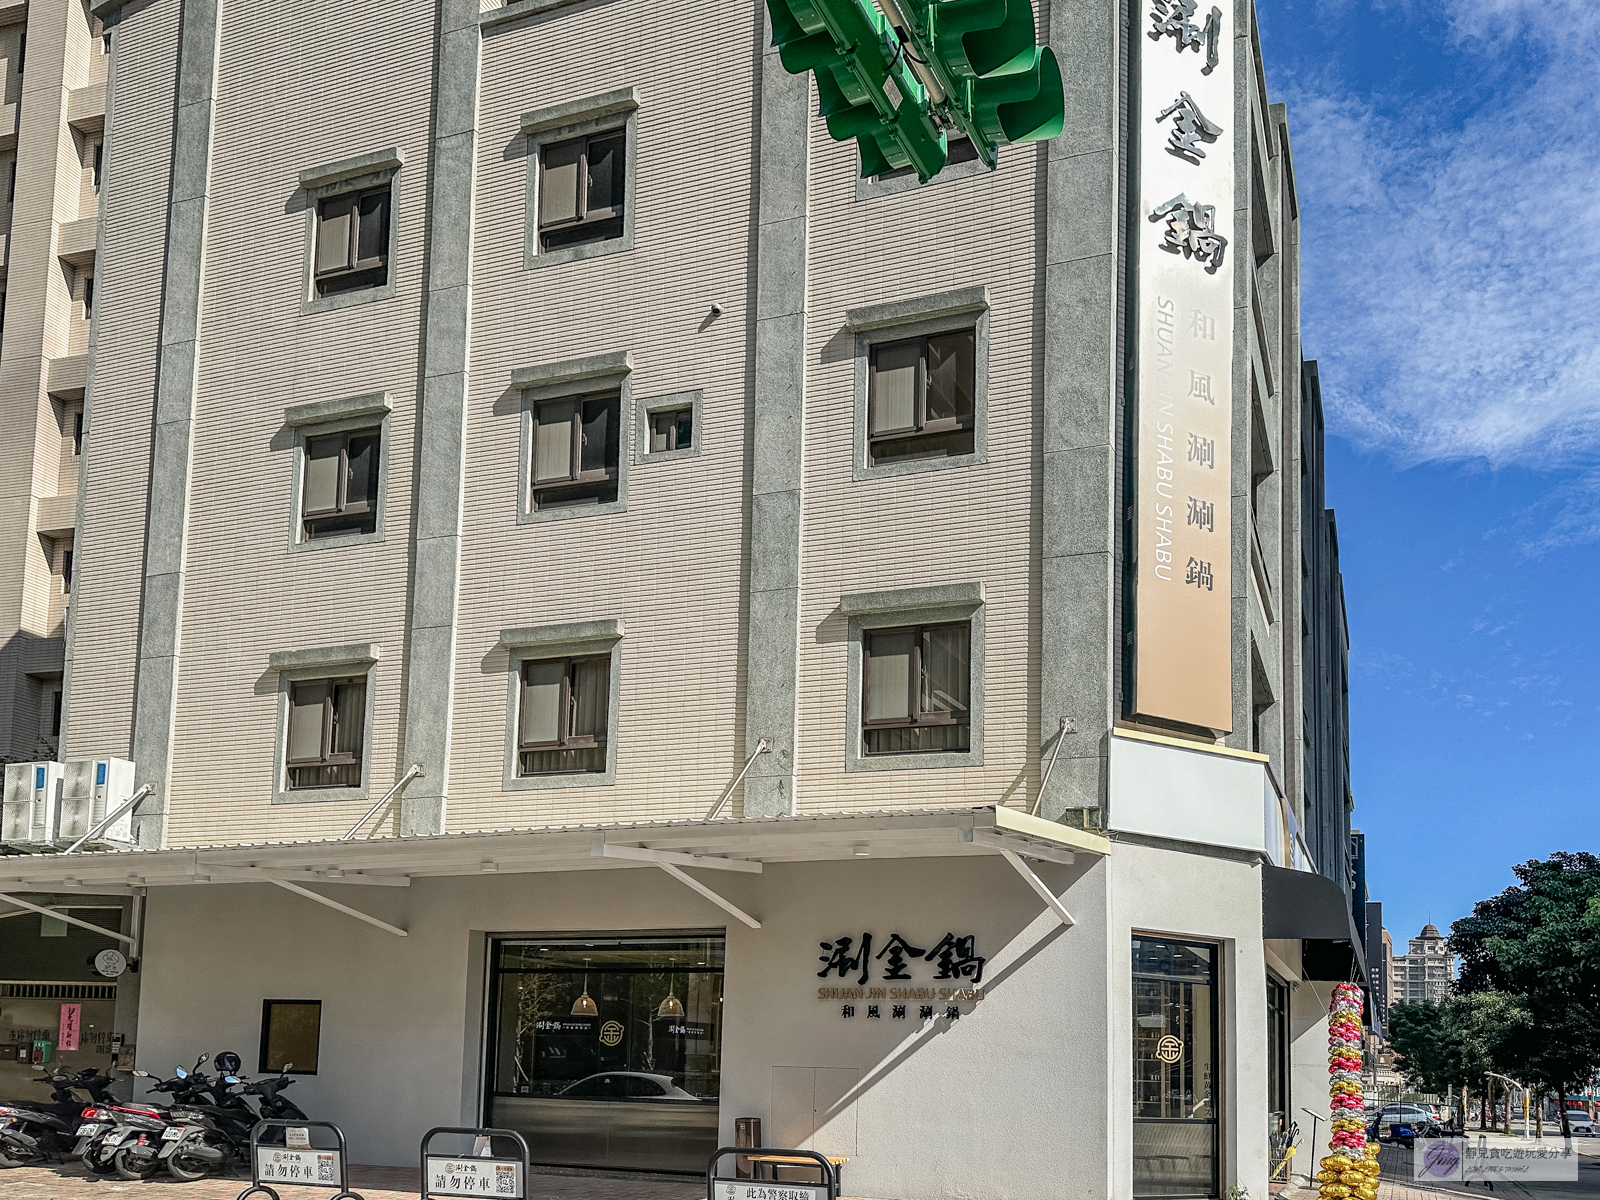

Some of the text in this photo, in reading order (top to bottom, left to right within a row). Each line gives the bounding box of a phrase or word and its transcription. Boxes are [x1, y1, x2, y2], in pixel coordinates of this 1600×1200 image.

[1155, 420, 1174, 499] SHABU
[1185, 308, 1217, 592] 和風涮涮鍋
[1153, 501, 1173, 581] SHABU
[816, 932, 986, 985] 涮金鍋
[817, 987, 986, 1000] SHUAN JIN SHABU SHABU
[841, 1005, 960, 1019] 和風涮涮鍋
[264, 1163, 314, 1179] 請勿停車
[435, 1174, 490, 1191] 請勿停車
